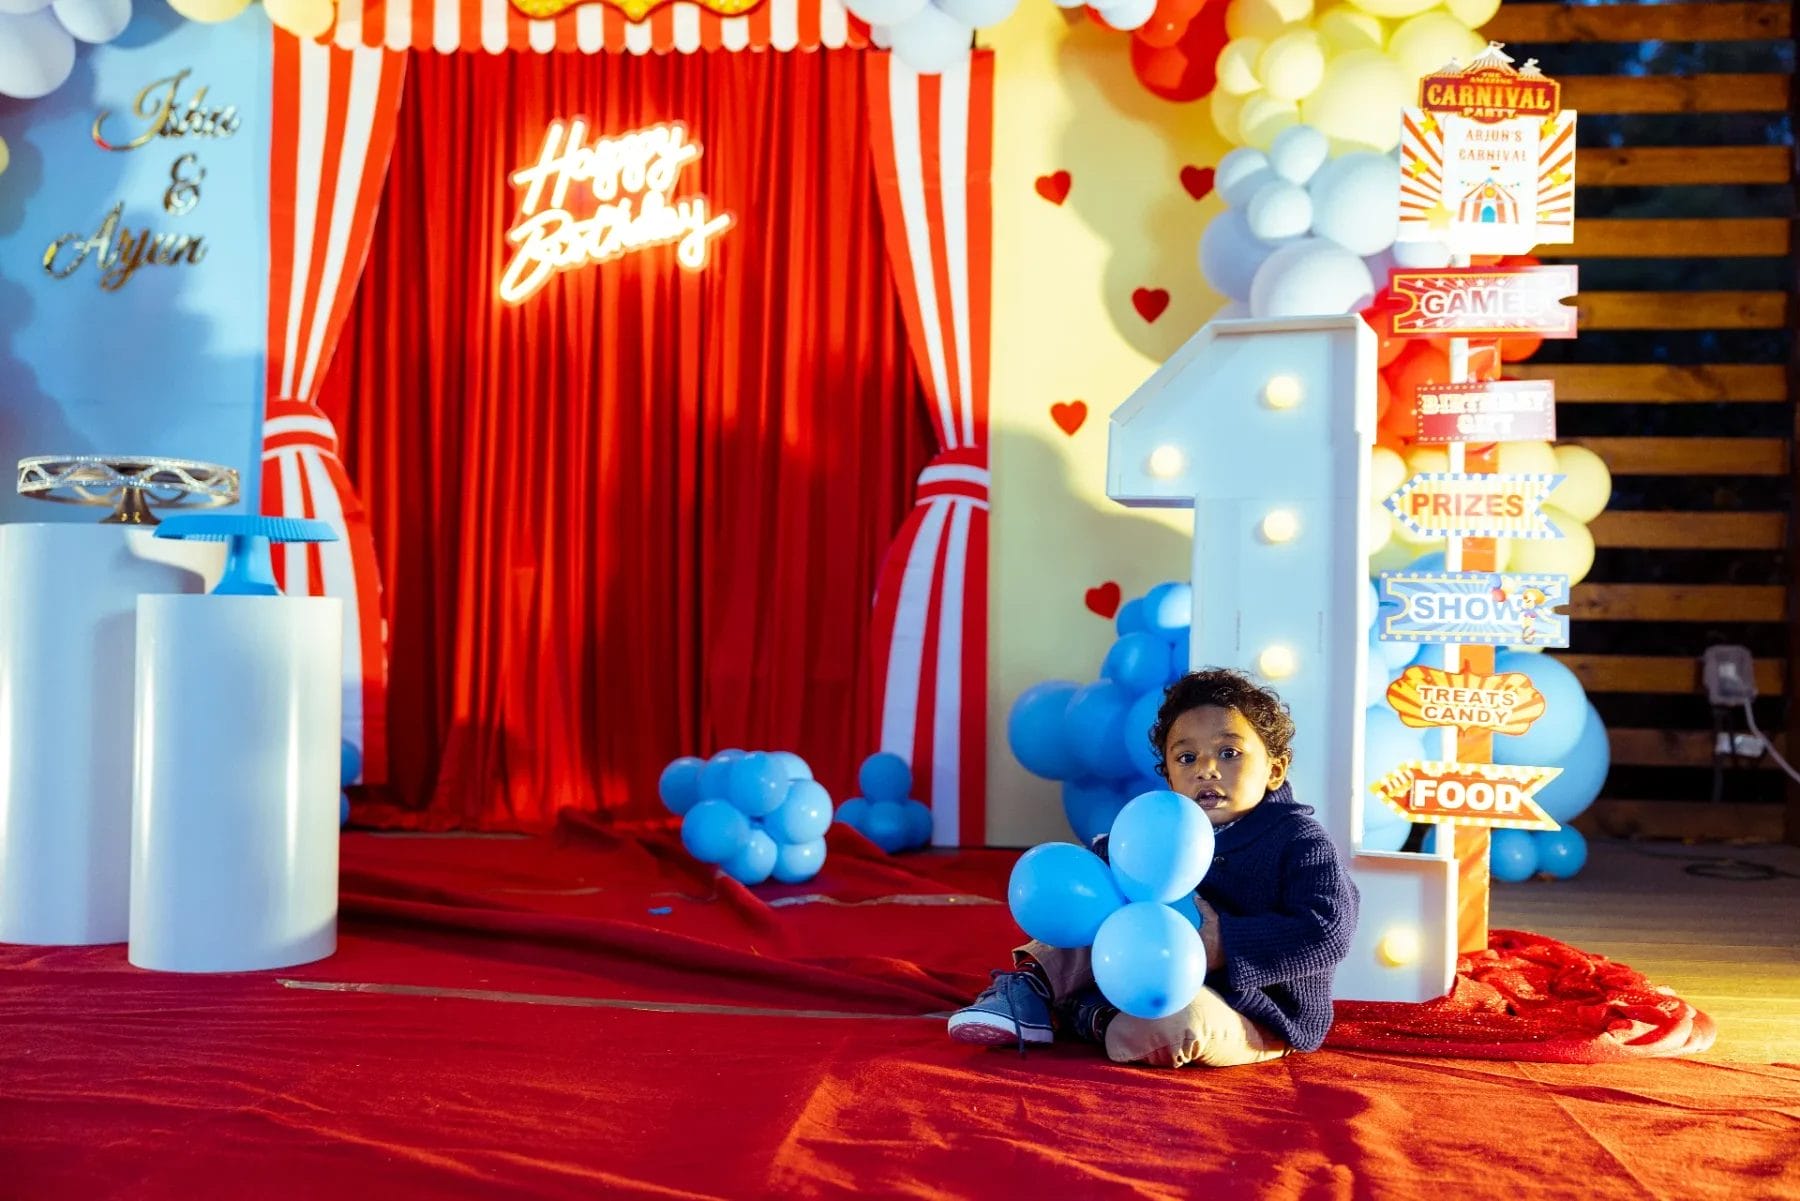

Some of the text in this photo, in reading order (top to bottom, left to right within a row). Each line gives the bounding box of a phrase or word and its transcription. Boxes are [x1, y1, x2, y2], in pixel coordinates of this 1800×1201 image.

[1427, 84, 1551, 110] CARNIVAL
[1463, 106, 1517, 118] PARTY
[511, 118, 699, 216] Happy
[1458, 148, 1528, 162] CARNIVAL
[163, 153, 207, 216] &
[499, 190, 732, 302] Birthday
[1411, 492, 1524, 518] PRIZES
[1412, 594, 1524, 622] SHOW
[1419, 687, 1515, 706] TREATS
[1424, 706, 1508, 724] CANDY
[1414, 779, 1521, 812] FOOD
